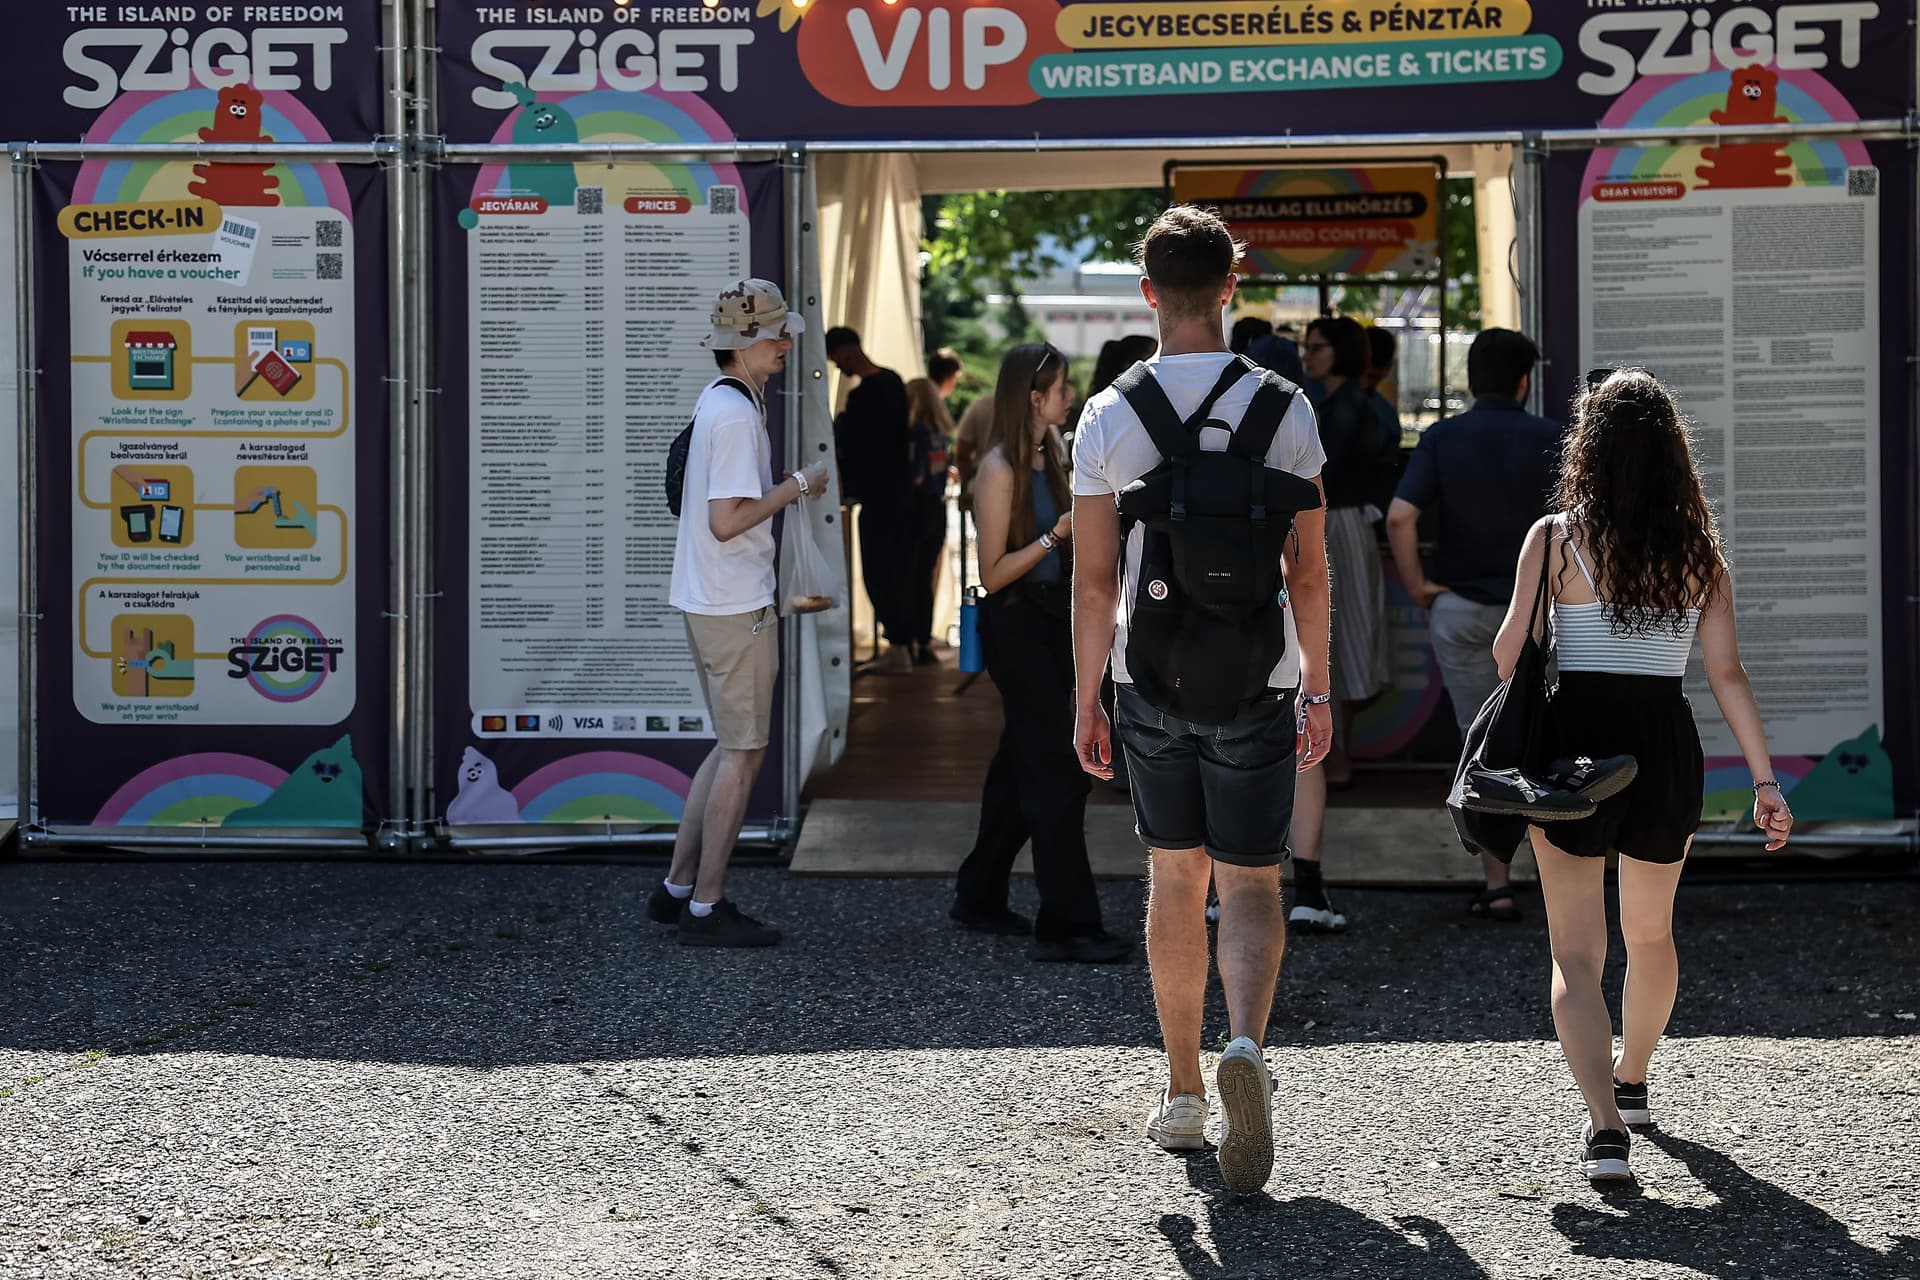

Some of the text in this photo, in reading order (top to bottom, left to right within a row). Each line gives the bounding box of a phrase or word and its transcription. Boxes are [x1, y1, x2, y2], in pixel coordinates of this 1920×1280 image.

[67, 6, 344, 22] THE ISLAND OF FREEDOM
[476, 6, 751, 23] THE ISLAND OF FREEDOM
[1082, 1, 1503, 38] JEGYBECSERÉLÉS & PÉNZTÁR
[846, 7, 1028, 91] VIP
[1041, 47, 1547, 88] WRISTBAND EXCHANGE & TICKETS
[1600, 185, 1678, 198] DEAR VISITOR!
[479, 199, 539, 211] JEGYÁRAK
[637, 200, 677, 210] PRICES
[73, 207, 204, 232] CHECK-IN
[1318, 227, 1399, 242] CONTROL
[82, 250, 222, 262] Vócserrel érkezem
[83, 266, 240, 281] If you have a voucher
[100, 295, 130, 303] Keresd
[269, 296, 323, 304] voucheredet
[147, 304, 182, 312] feliratot
[207, 305, 333, 316] és fényképes igazolványodat
[111, 407, 183, 417] Look for the sign
[210, 408, 333, 418] Prepare your voucher and ID
[214, 417, 263, 427] (containing
[273, 417, 298, 427] photo
[300, 417, 310, 425] of
[312, 418, 331, 427] you)
[119, 442, 178, 452] Igazolványod
[248, 443, 306, 453] karszalagod
[110, 450, 187, 459] beolvasásra kerül
[286, 452, 309, 460] kerül
[154, 487, 165, 496] ID
[163, 552, 200, 561] checked
[224, 553, 243, 561] Your
[246, 553, 290, 561] wristband
[310, 553, 321, 561] be
[97, 562, 201, 572] by the document reader
[244, 563, 301, 573] personalized
[108, 590, 160, 601] karszalagot
[132, 600, 176, 608] csuklódra
[230, 637, 246, 645] THE
[250, 637, 283, 645] ISLAND
[116, 703, 131, 712] put
[133, 704, 152, 712] your
[154, 703, 199, 711] wristband
[135, 713, 154, 722] your
[573, 717, 604, 729] VISA
